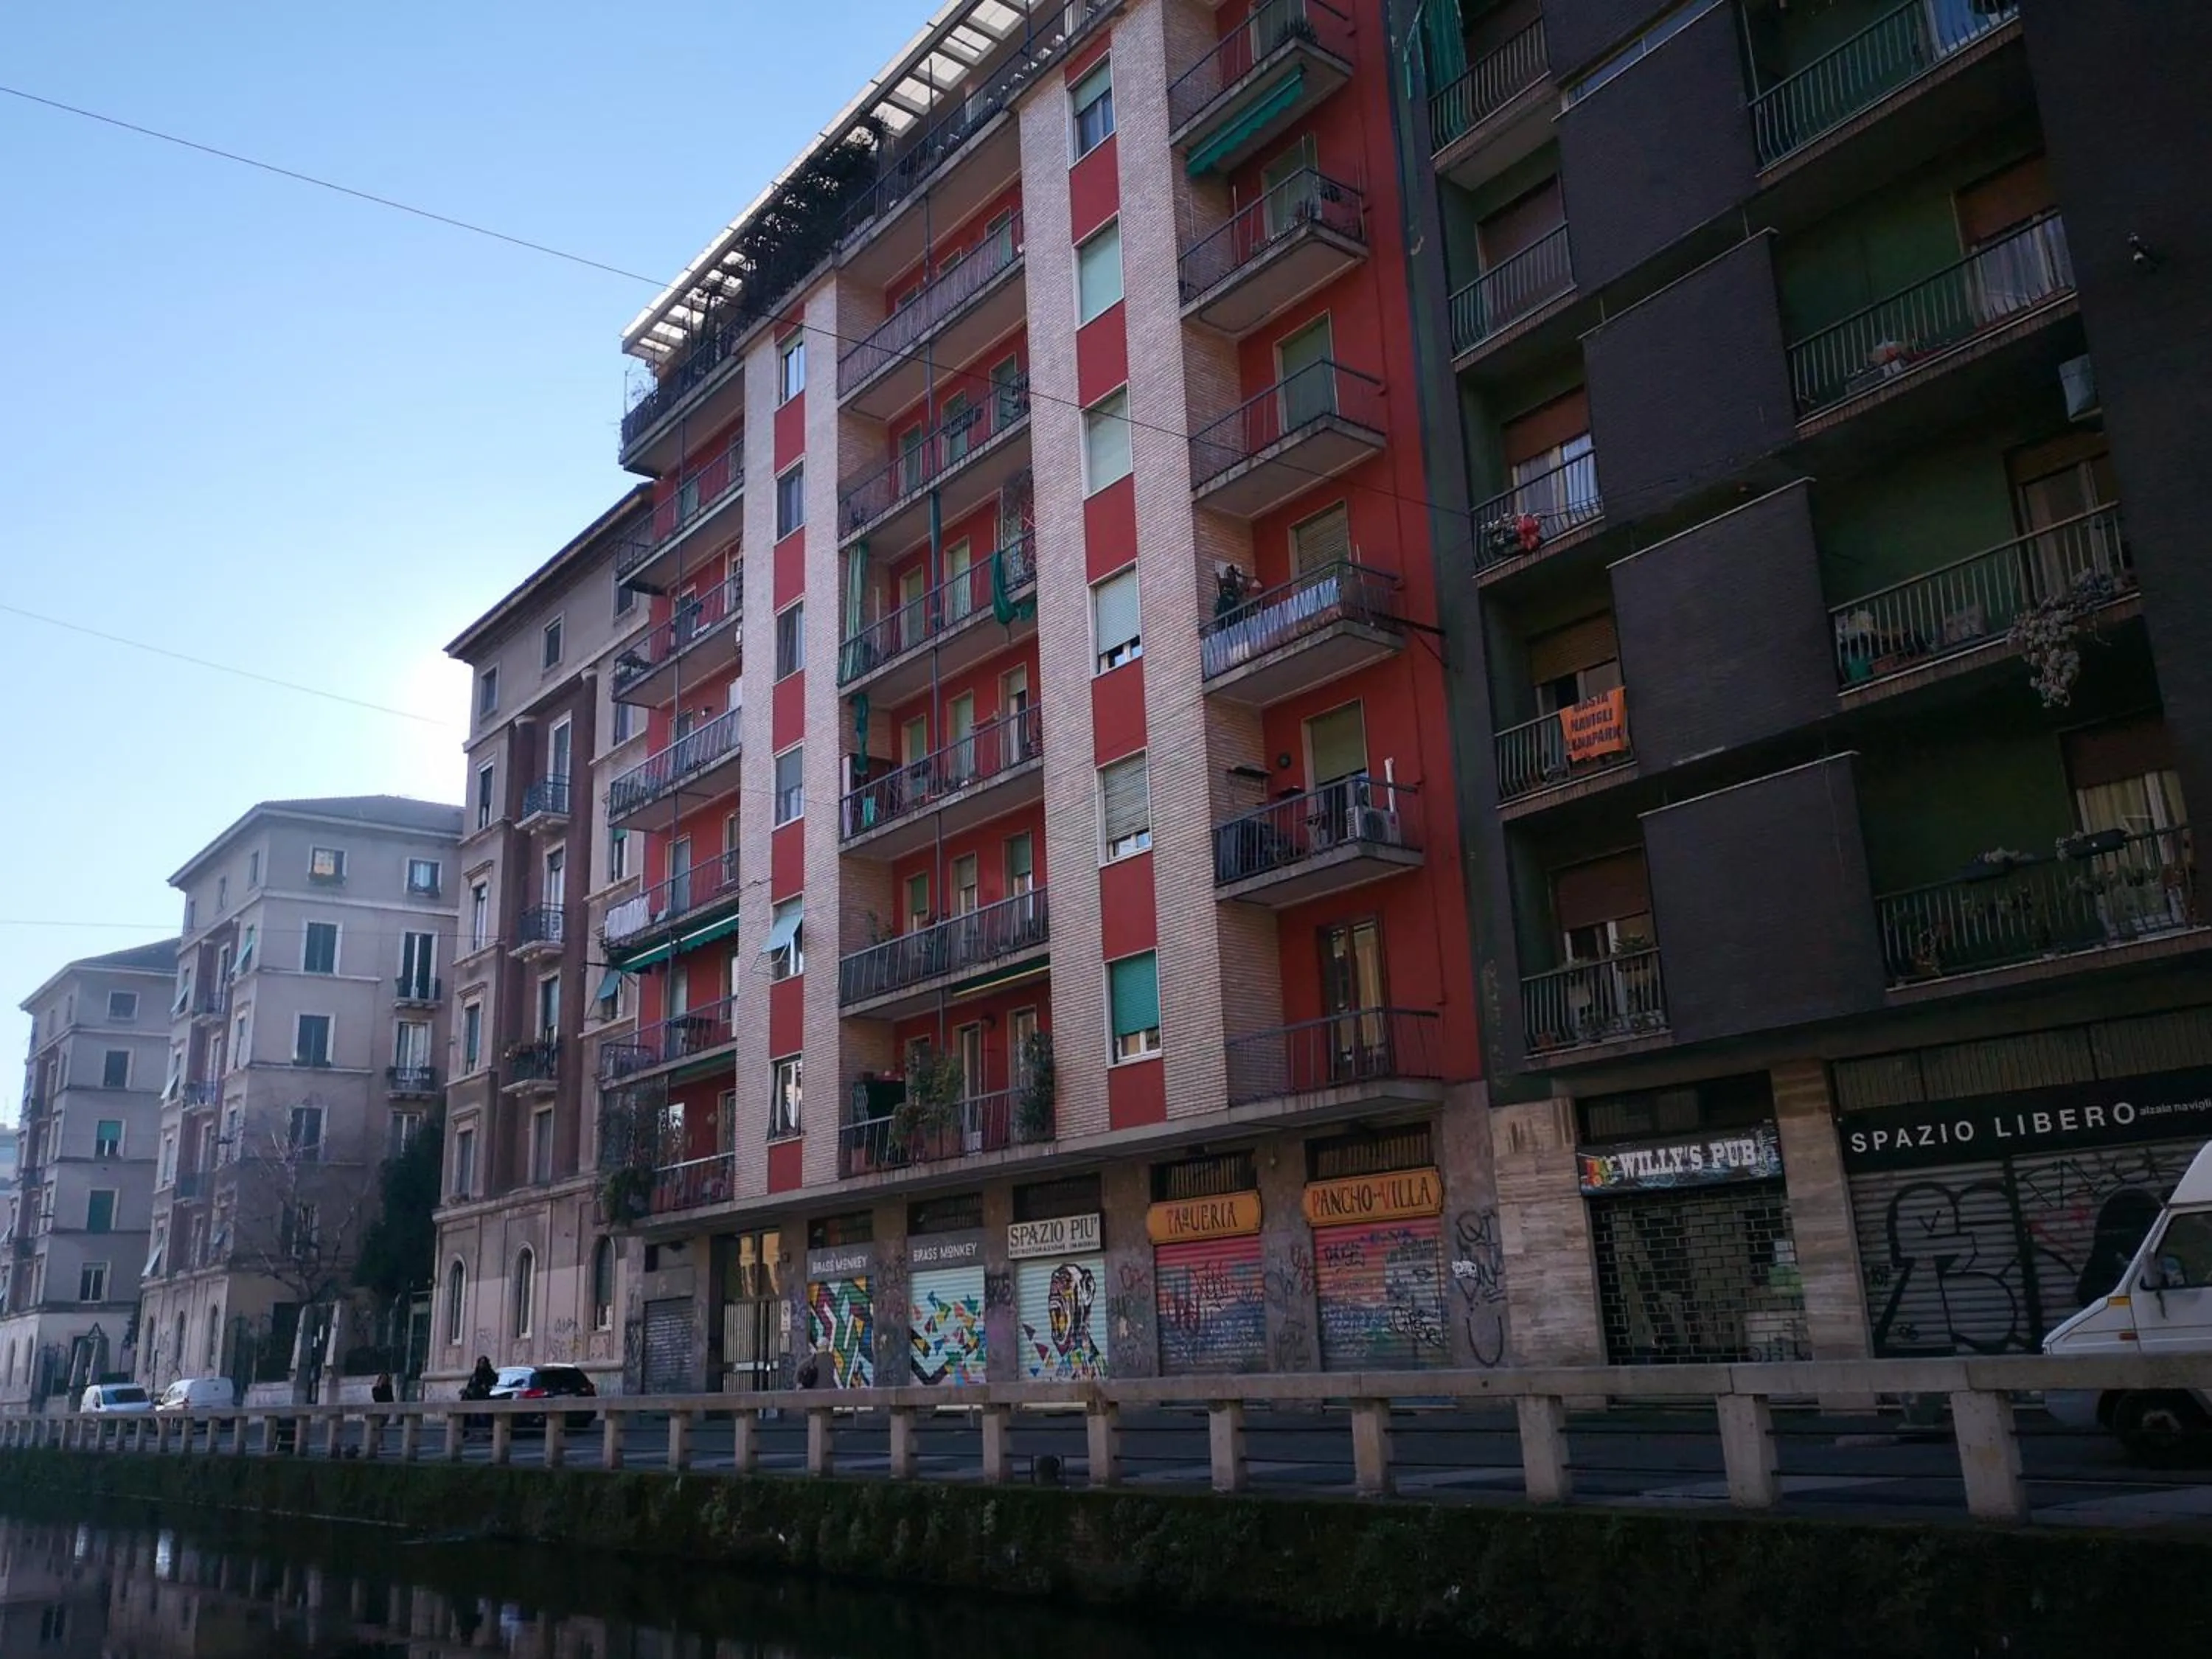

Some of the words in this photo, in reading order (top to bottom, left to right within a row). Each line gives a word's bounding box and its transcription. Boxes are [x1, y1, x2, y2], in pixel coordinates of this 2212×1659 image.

[1850, 1120, 1975, 1154] SPAZIO
[1994, 1102, 2136, 1138] LIBERO
[1617, 1144, 1703, 1180] WILLY'S
[1708, 1138, 1757, 1169] PUB
[1166, 1200, 1238, 1235] TAQUERIA
[1009, 1220, 1064, 1248] SPAZIO
[812, 1259, 835, 1275] BRASS
[835, 1254, 869, 1272] MONKEY
[913, 1247, 938, 1263] BRASS
[939, 1242, 977, 1260] MONKEY
